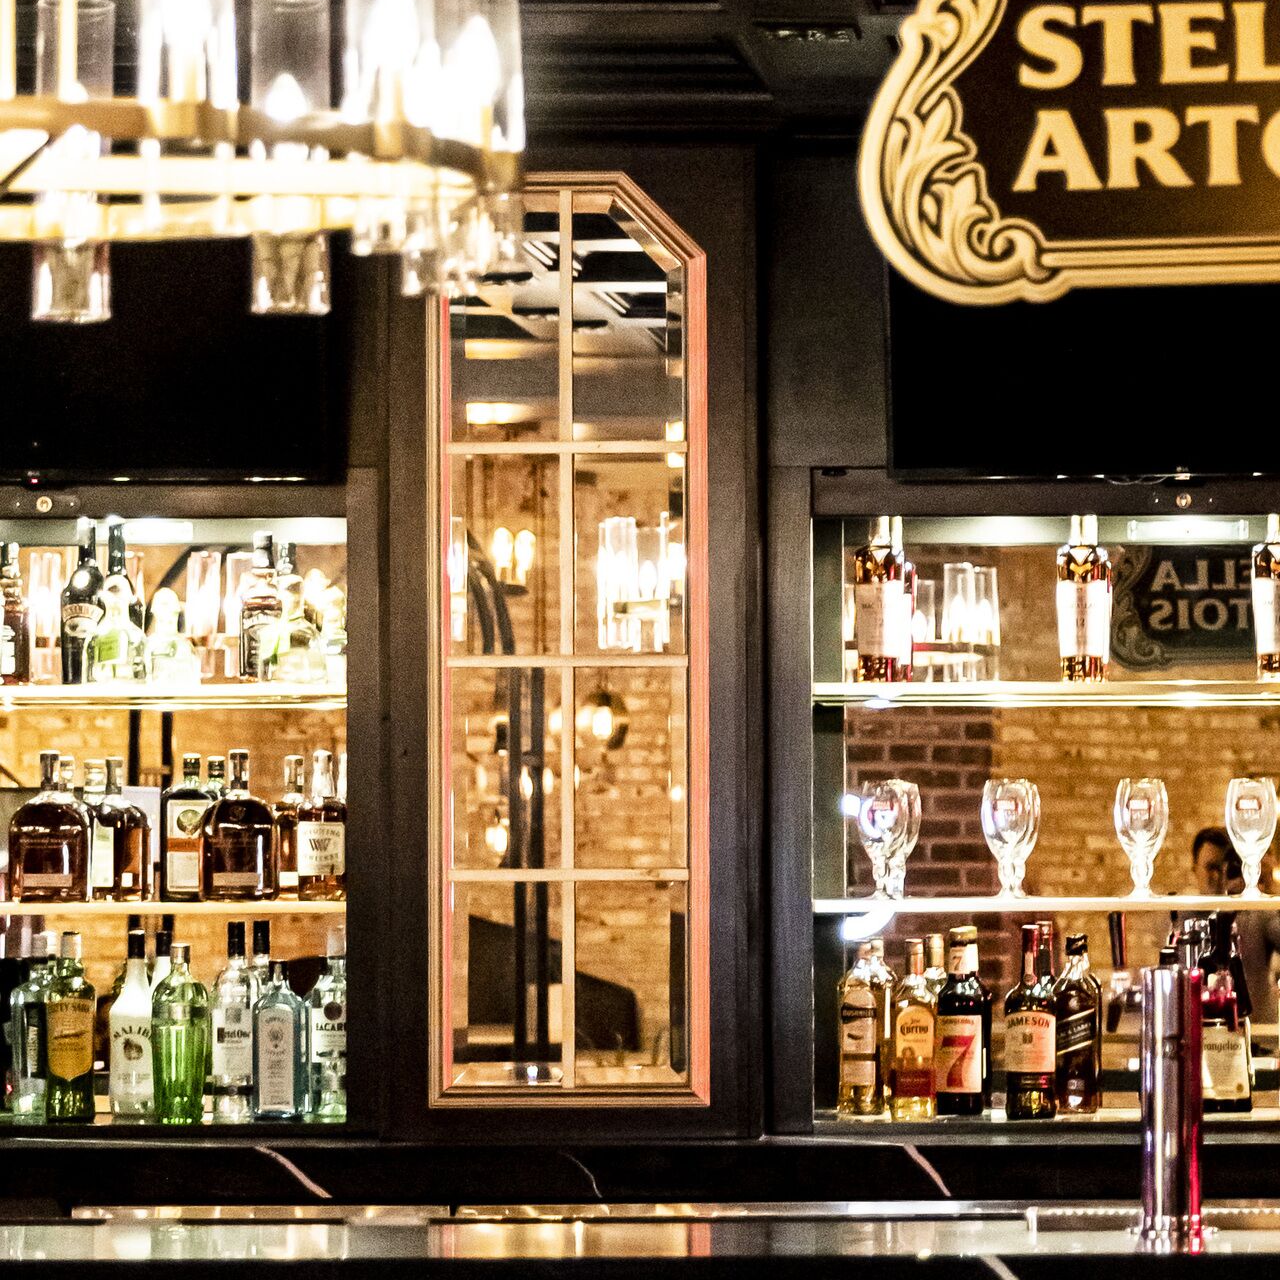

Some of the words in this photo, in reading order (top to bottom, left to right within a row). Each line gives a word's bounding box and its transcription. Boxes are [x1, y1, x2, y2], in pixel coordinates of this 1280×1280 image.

[1007, 1015, 1051, 1030] JAMESON
[113, 1025, 152, 1039] MALIB
[942, 1035, 976, 1088] 7
